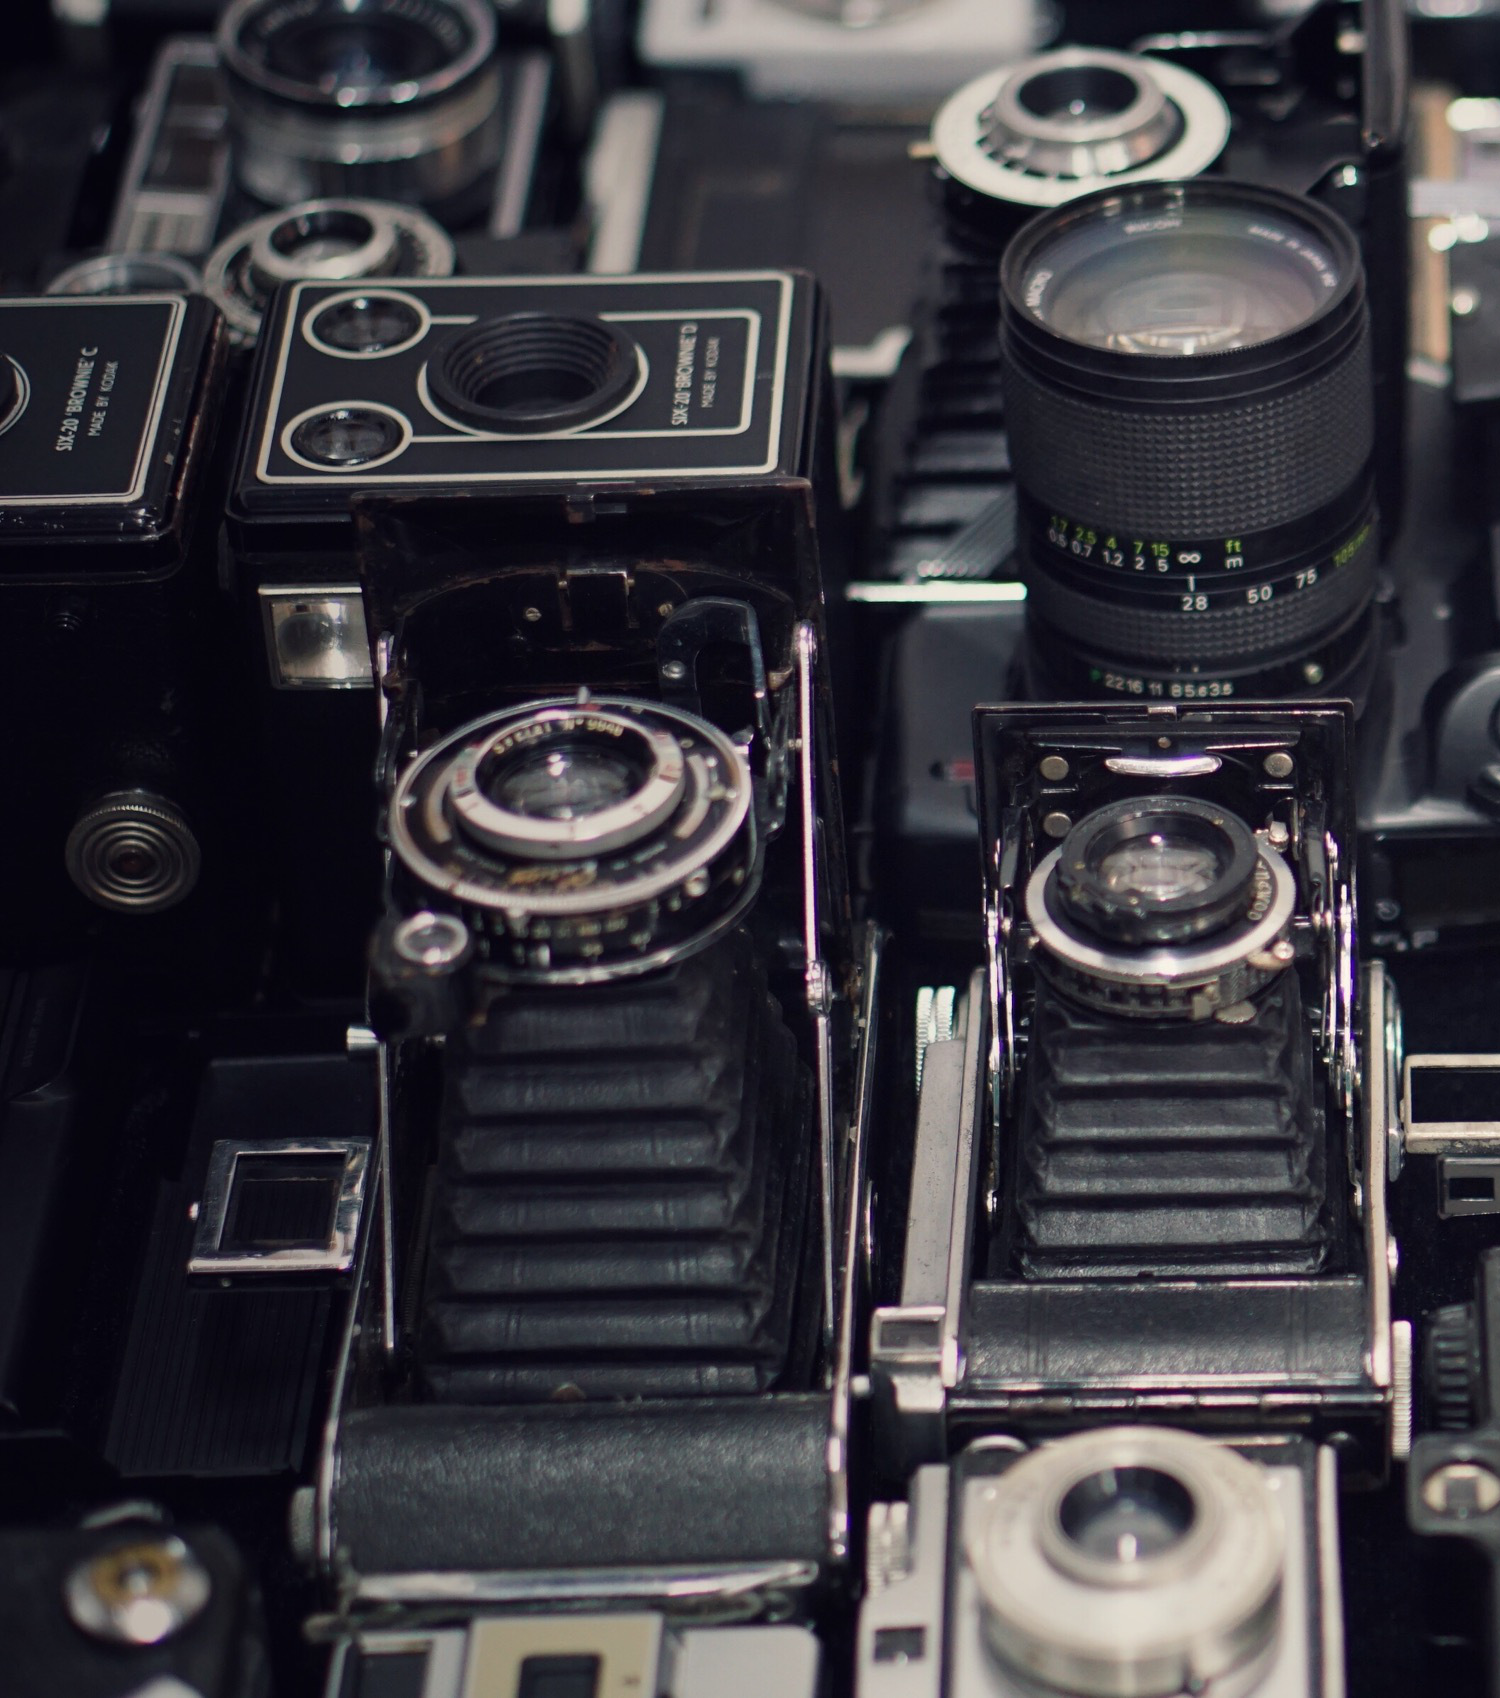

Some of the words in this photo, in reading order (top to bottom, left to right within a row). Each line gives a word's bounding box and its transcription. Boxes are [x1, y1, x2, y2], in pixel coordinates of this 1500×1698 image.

[706, 336, 720, 369] KODAK
[100, 361, 119, 392] KODAK
[704, 369, 717, 382] BY
[55, 418, 80, 451] SIX-20
[81, 346, 98, 357] C
[95, 396, 109, 407] BY
[671, 390, 691, 426] SIX-20
[701, 382, 716, 408] MADE
[88, 411, 106, 437] MADE
[1071, 540, 1092, 558] 0.7
[1103, 551, 1123, 567] 1.2
[1135, 556, 1145, 571] 2
[1157, 559, 1169, 572] 5
[1225, 555, 1244, 569] m
[1106, 537, 1118, 550] 4
[1133, 541, 1144, 554] 7
[1152, 543, 1170, 558] 15
[1225, 540, 1242, 554] ft
[1182, 596, 1208, 611] 28
[1247, 585, 1273, 604] 50
[1296, 568, 1318, 589] 75
[1105, 673, 1125, 691] 22
[1127, 679, 1143, 694] 16
[1150, 682, 1163, 696] 11
